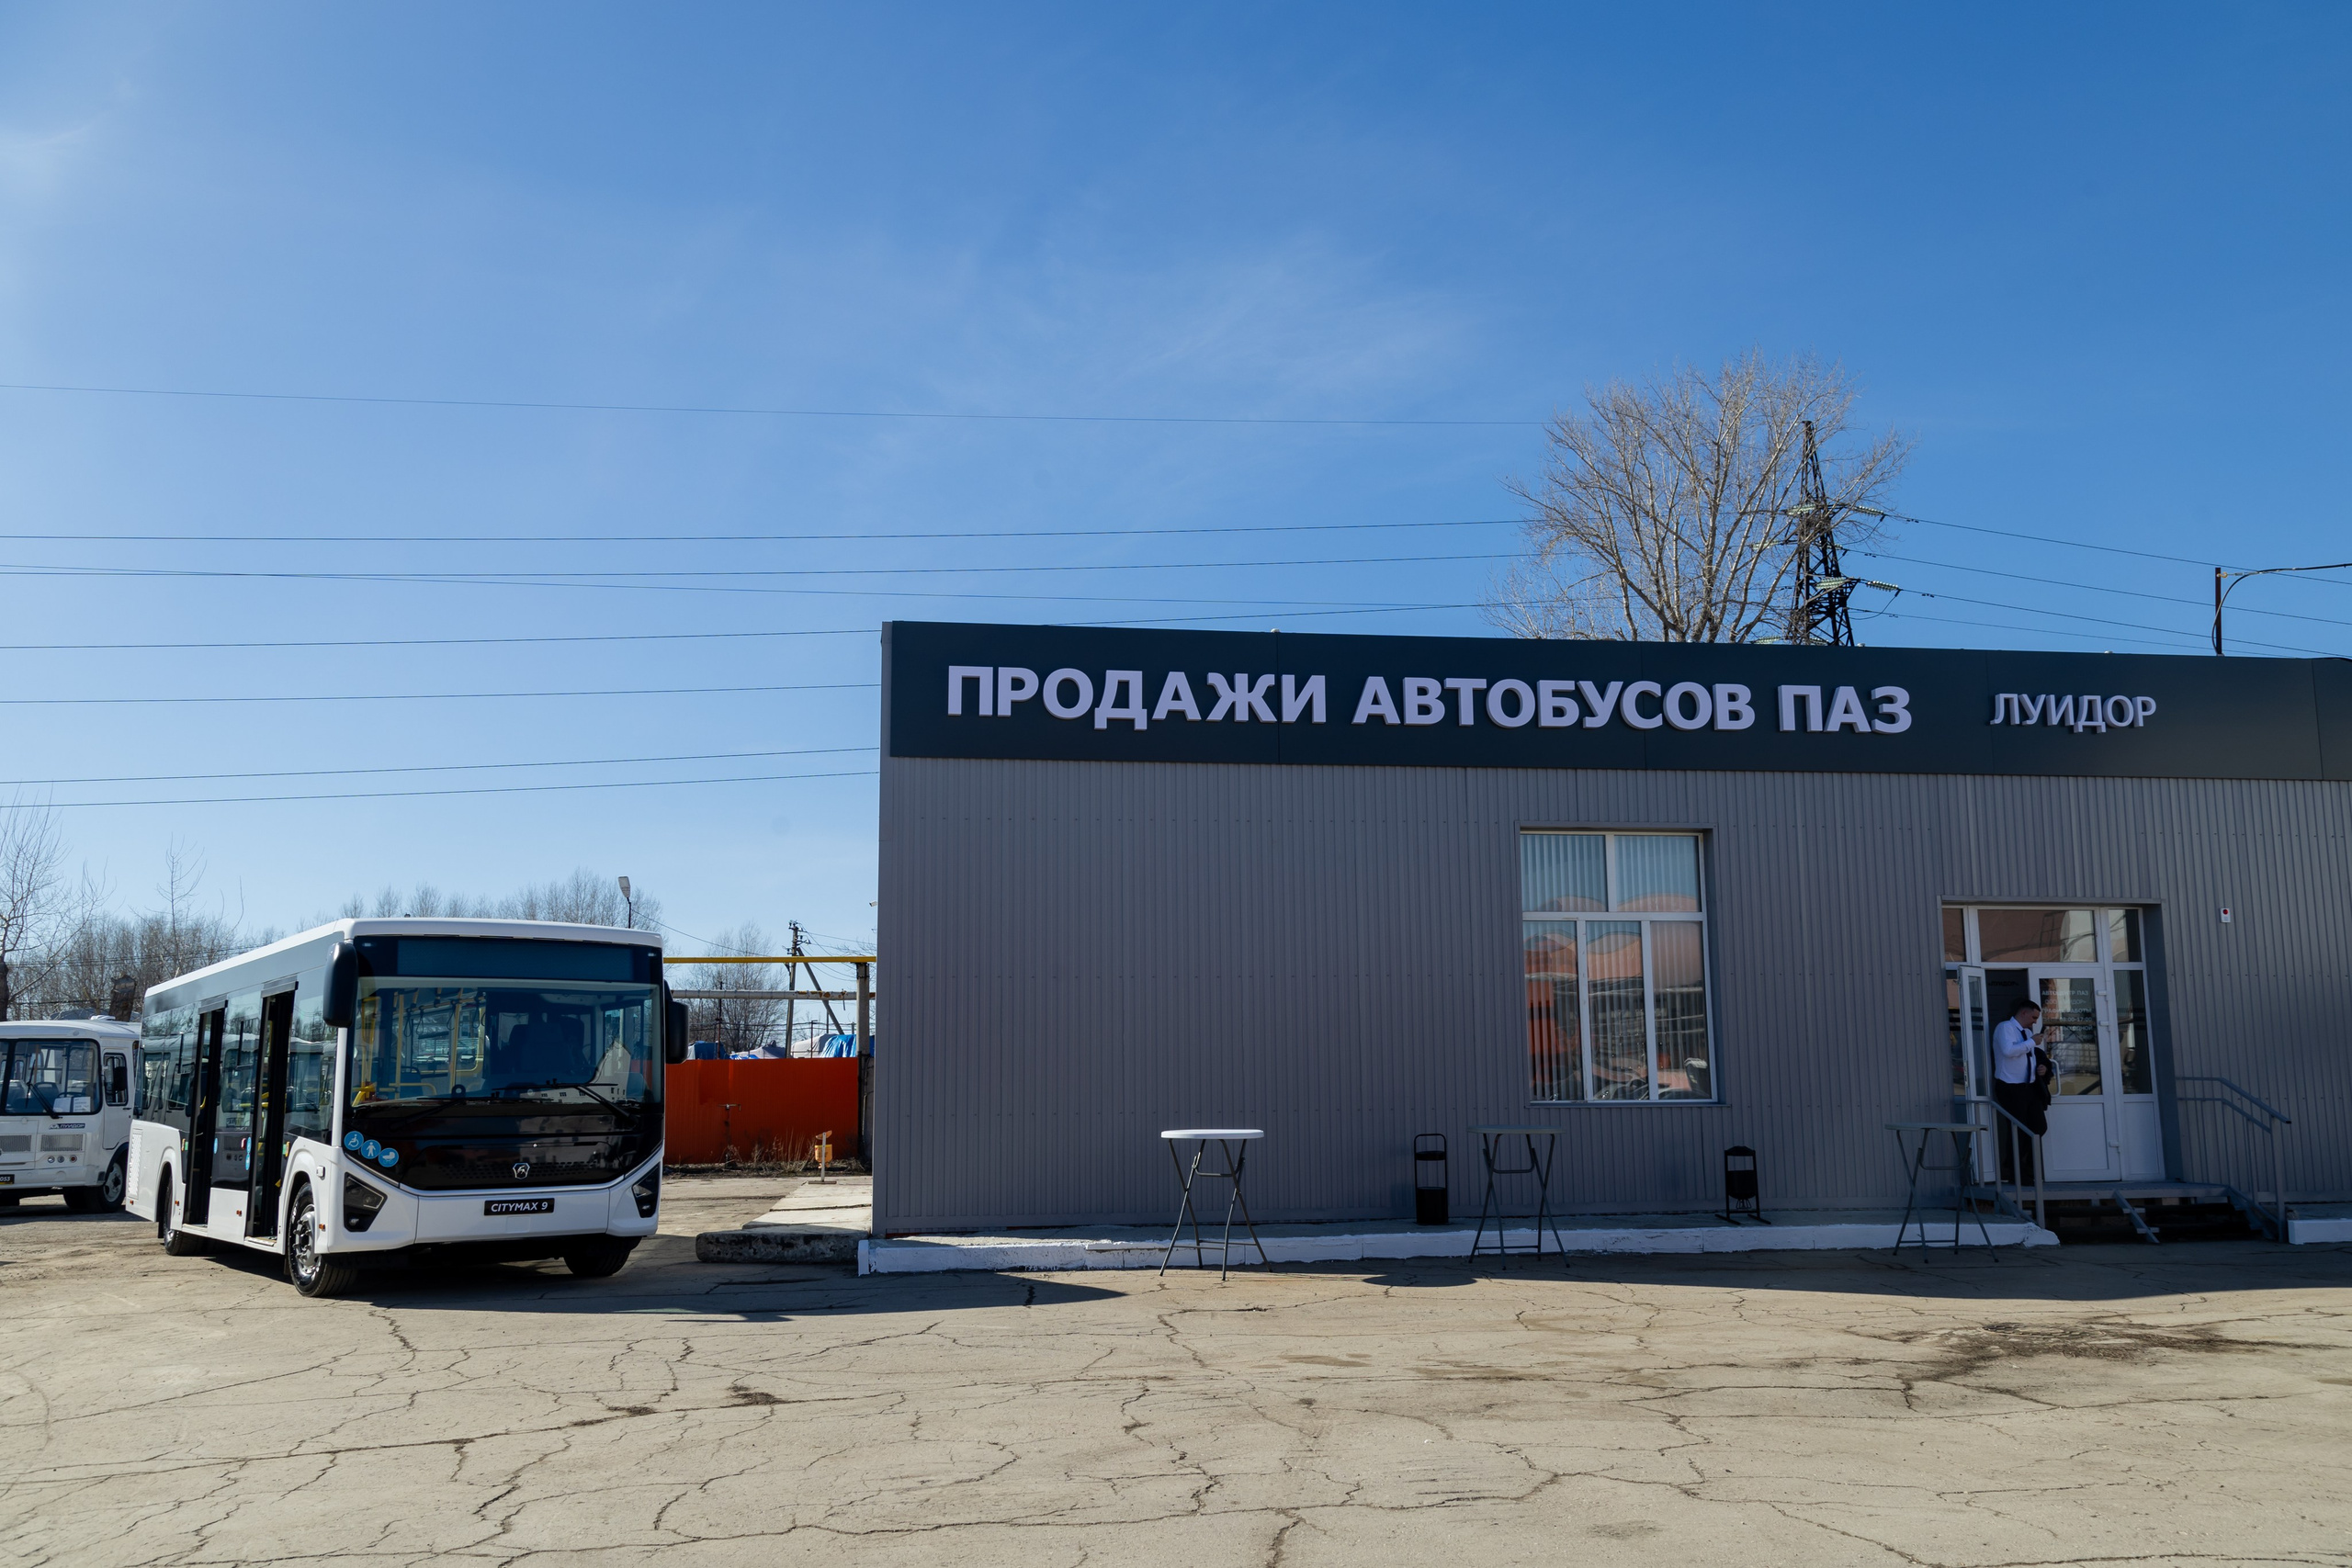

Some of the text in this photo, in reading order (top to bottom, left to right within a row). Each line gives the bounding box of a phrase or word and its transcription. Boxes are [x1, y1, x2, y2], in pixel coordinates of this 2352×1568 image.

[947, 665, 1912, 735] ПРОДАЖИ АВТОБУСОВ ПАЗ
[1989, 693, 2156, 734] ЛУИДОР
[491, 1201, 548, 1213] CITYMAX 9
